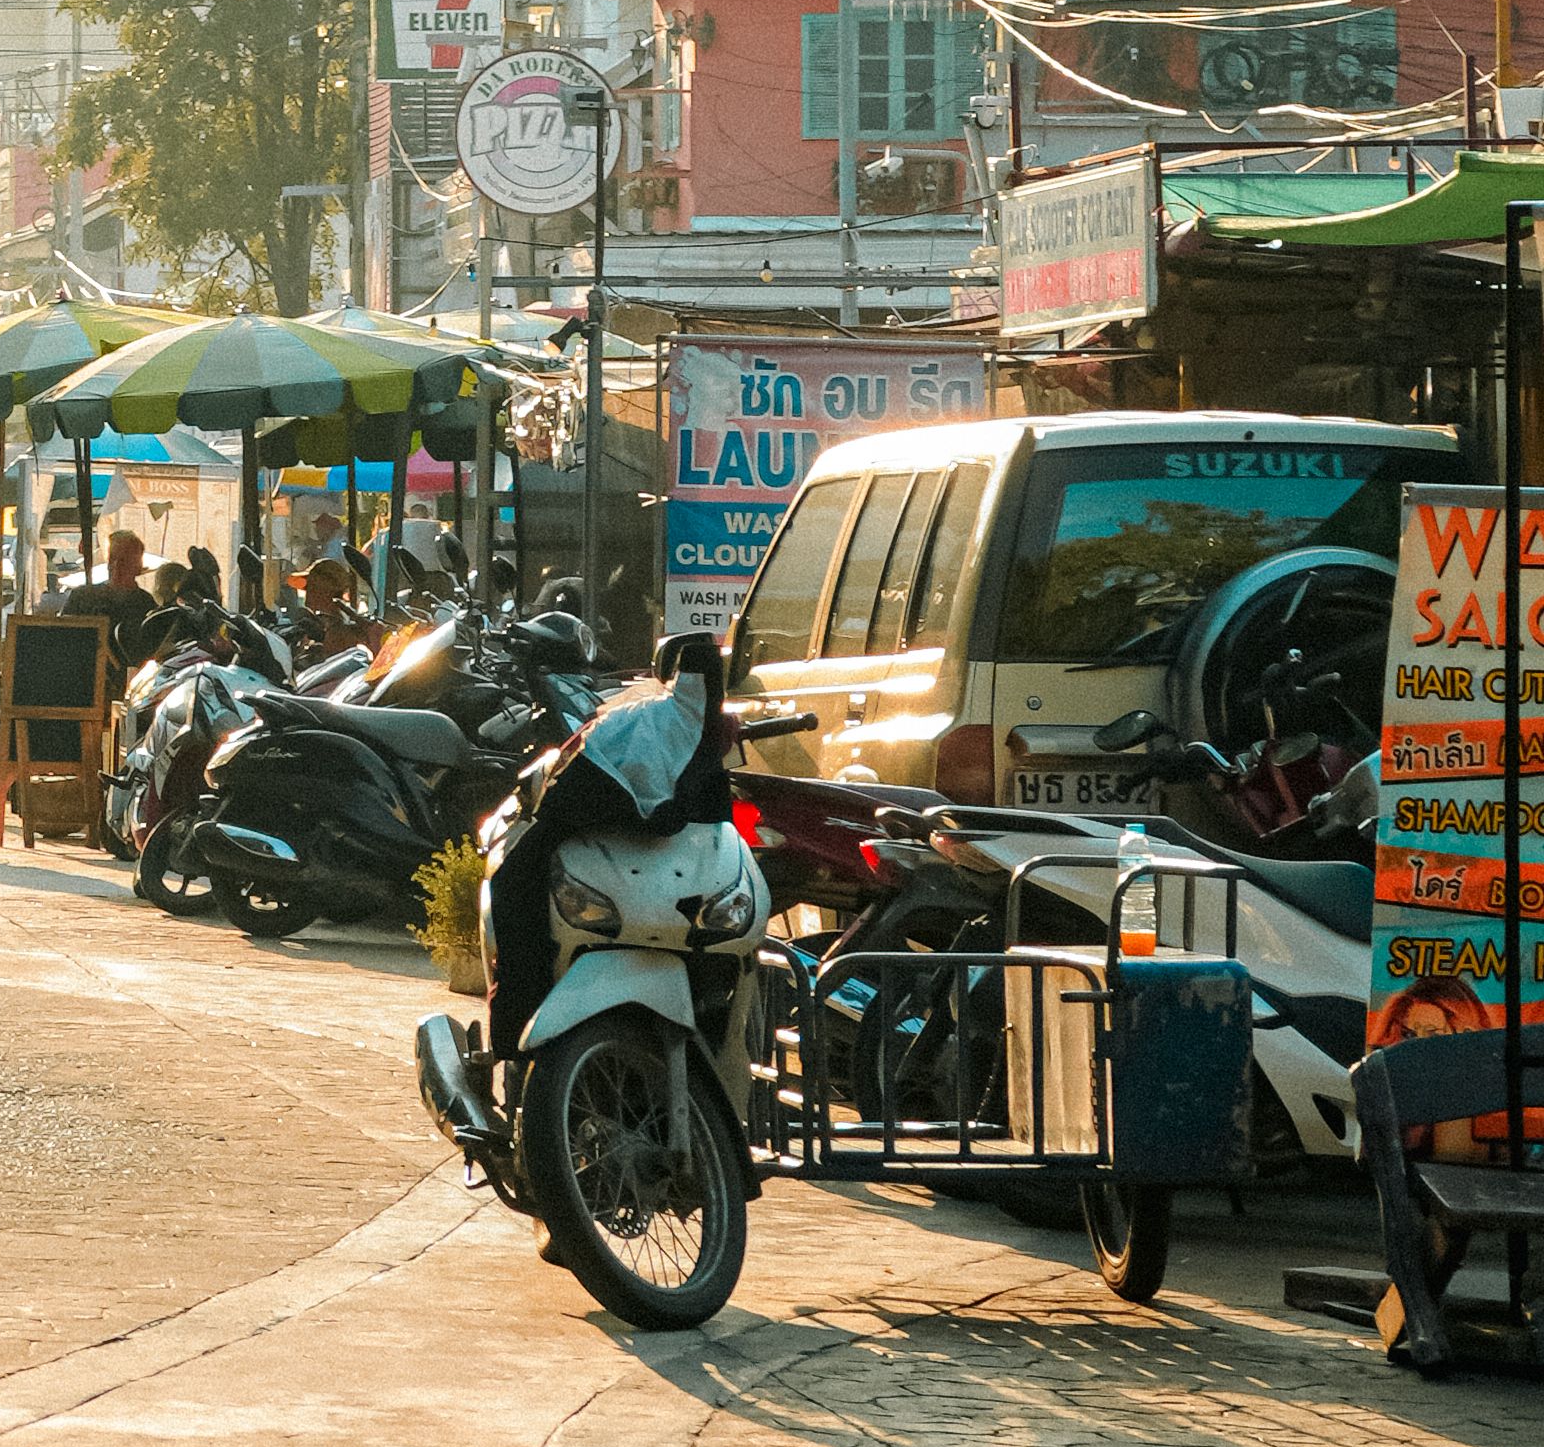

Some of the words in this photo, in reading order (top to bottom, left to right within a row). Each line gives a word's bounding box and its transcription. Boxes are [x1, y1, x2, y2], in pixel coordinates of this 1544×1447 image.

[477, 71, 505, 98] DA
[823, 375, 887, 420] อบ
[1164, 453, 1345, 478] SUZUKI
[151, 480, 190, 494] BOSS
[680, 591, 726, 606] WASH
[690, 612, 722, 627] GET
[1396, 664, 1474, 702] HAIR
[1392, 731, 1486, 772] ทำเล็บ
[1488, 877, 1544, 913] BO
